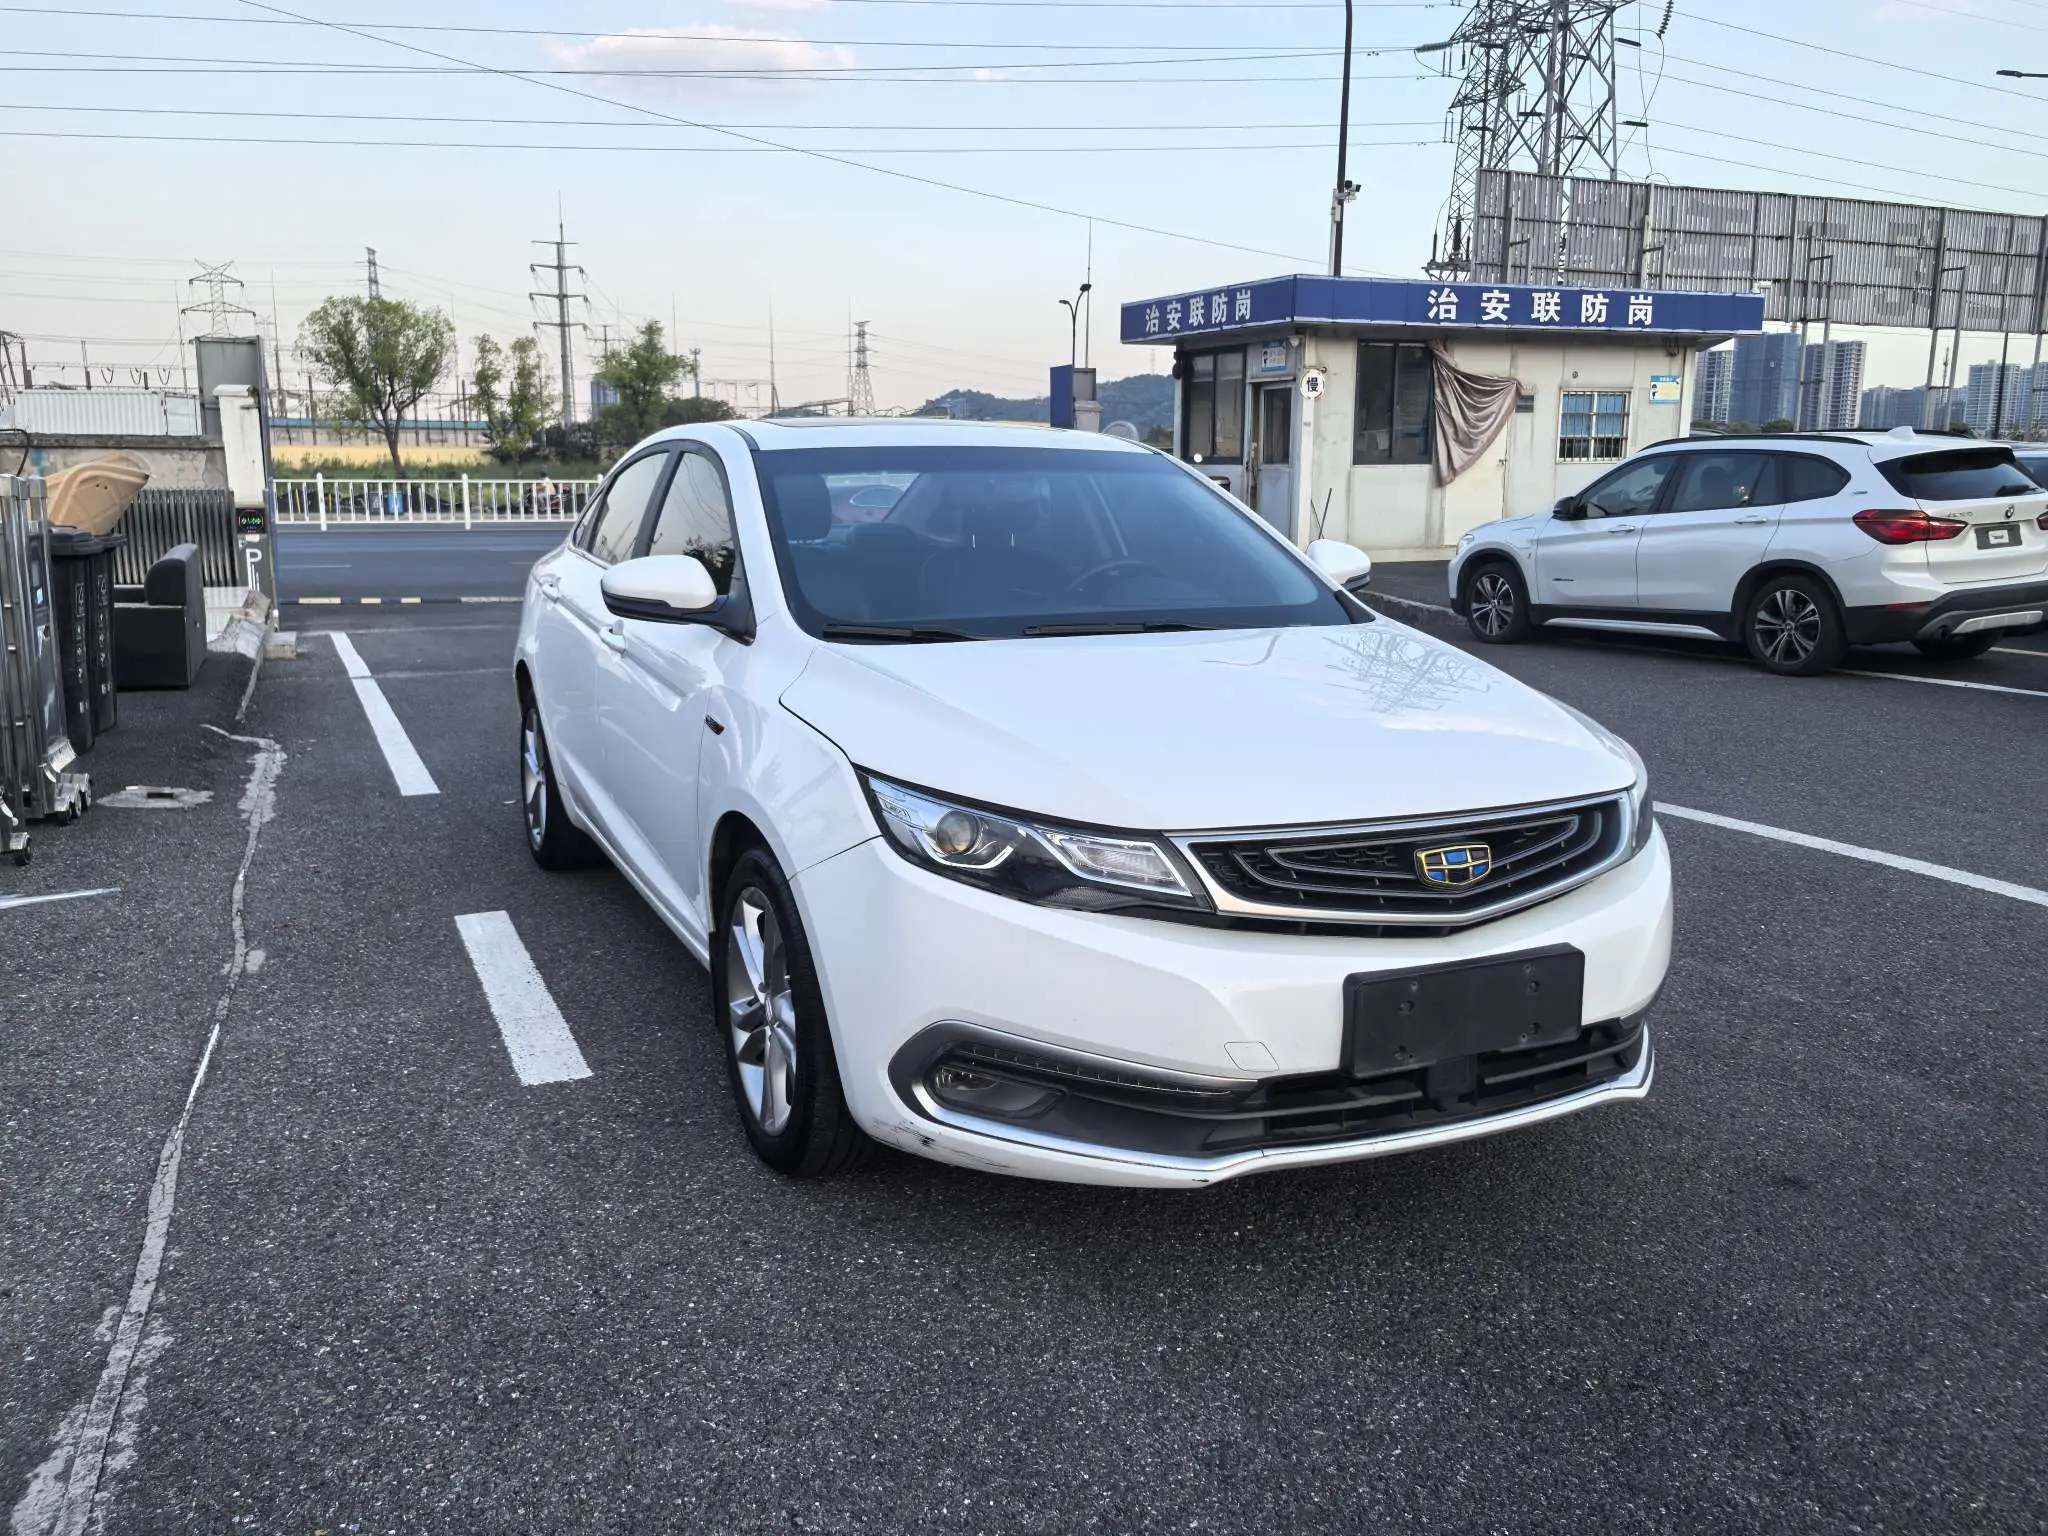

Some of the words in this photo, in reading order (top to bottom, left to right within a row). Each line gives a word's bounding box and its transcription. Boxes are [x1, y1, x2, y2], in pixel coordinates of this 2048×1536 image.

[1144, 288, 1252, 334] 治安联防岗
[1426, 286, 1654, 326] 治安联防岗
[1306, 376, 1319, 393] 慢
